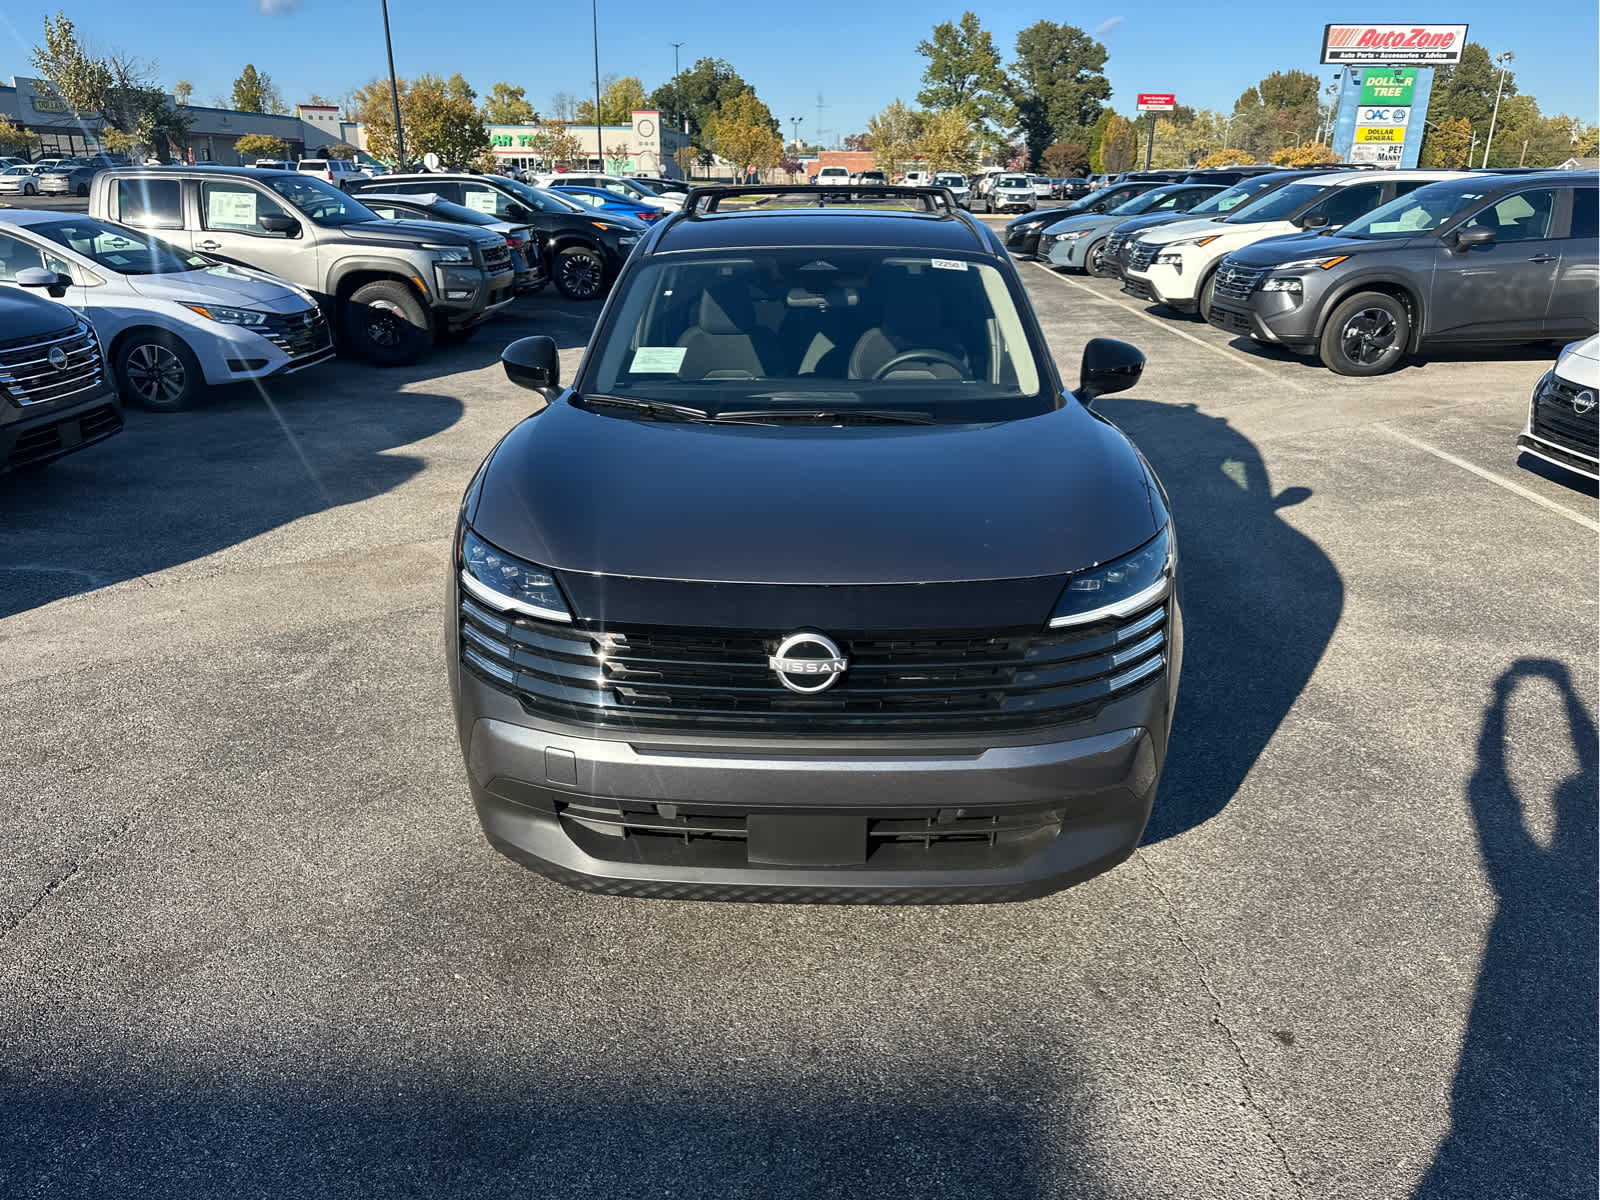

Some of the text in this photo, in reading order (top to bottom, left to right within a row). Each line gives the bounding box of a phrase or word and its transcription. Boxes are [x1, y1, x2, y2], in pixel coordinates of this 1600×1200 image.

[1356, 28, 1455, 47] AutoZone
[1373, 87, 1402, 97] TREE
[1364, 109, 1390, 120] OAC
[1388, 146, 1403, 154] PET
[769, 657, 847, 673] NISSAN
